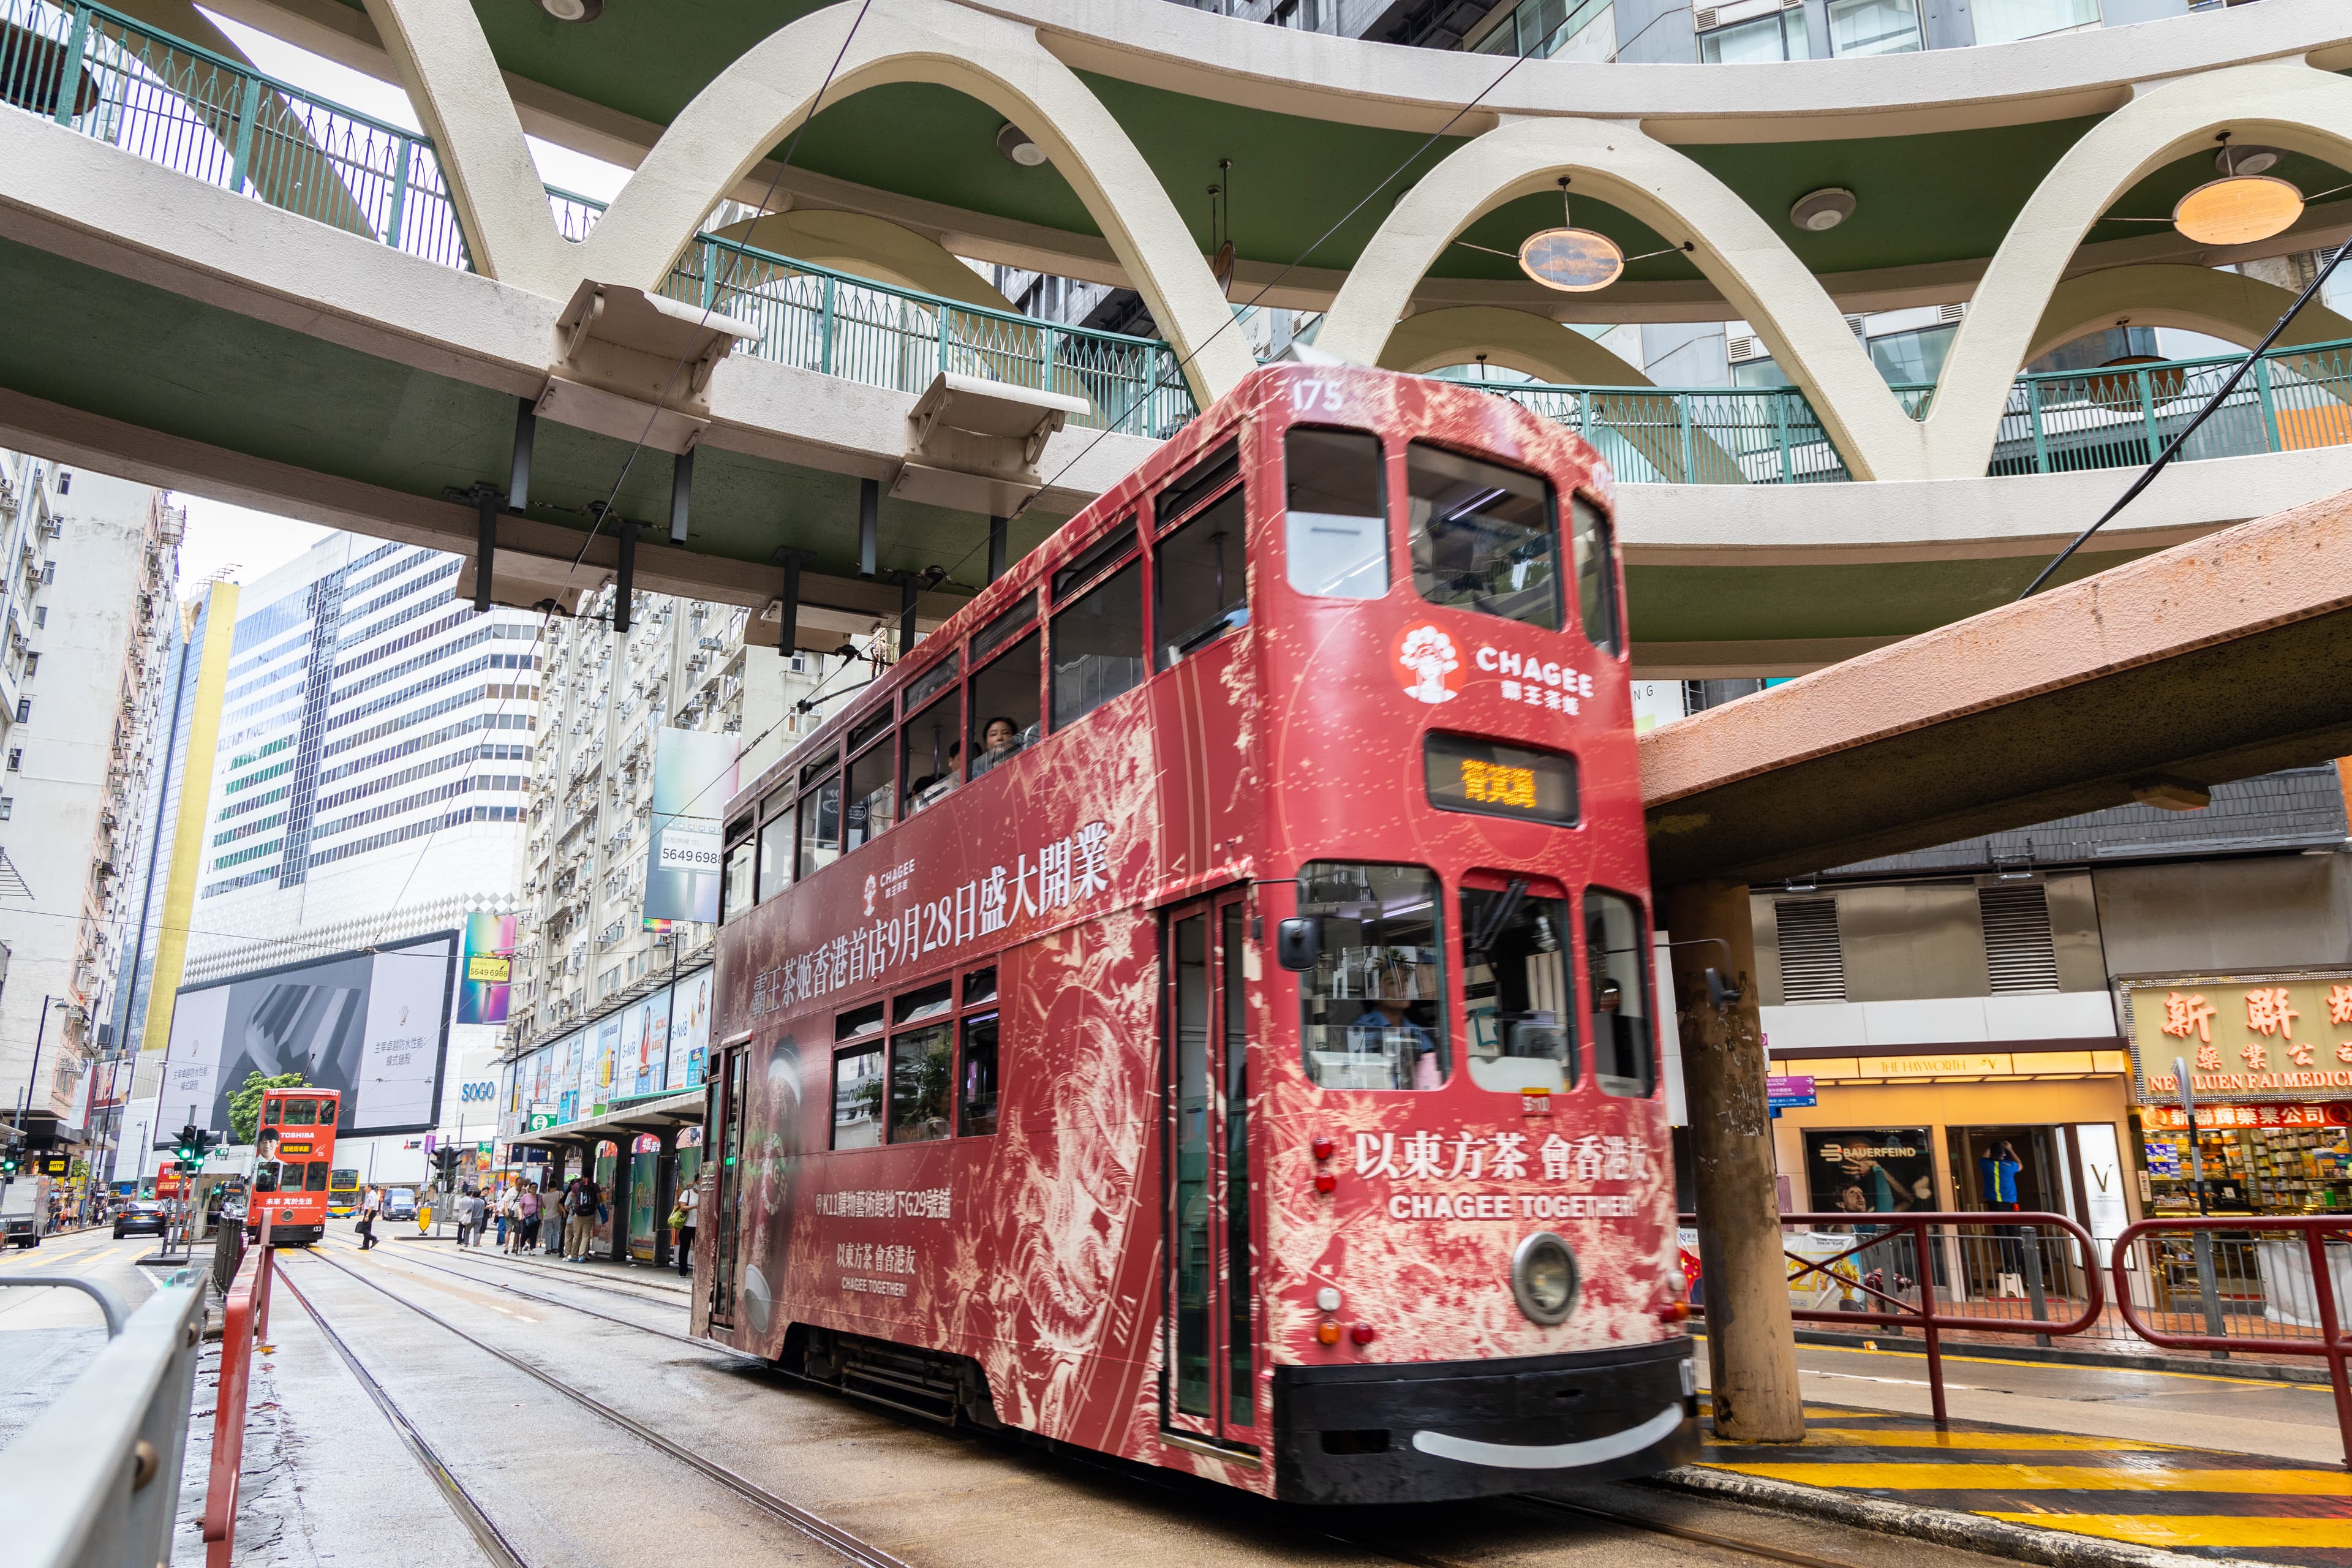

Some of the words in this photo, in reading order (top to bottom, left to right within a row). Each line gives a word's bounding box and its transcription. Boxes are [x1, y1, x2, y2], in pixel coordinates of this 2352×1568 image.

[1293, 378, 1343, 412] 175
[1476, 647, 1594, 698] CHAGEE
[663, 848, 693, 861] 5649
[880, 858, 915, 888] CHAGEE
[1881, 1062, 1898, 1072] THE
[1902, 1060, 1966, 1072] HAYWORTH
[461, 1080, 495, 1102] SOGO
[2148, 1074, 2180, 1091] NE
[2193, 1072, 2242, 1091] LUEN
[2244, 1072, 2280, 1090] FAI
[1355, 1131, 1529, 1180] 以東方茶
[1539, 1133, 1650, 1182] 會香港友
[1844, 1147, 1917, 1158] BAUERFEIND
[1389, 1195, 1513, 1219] CHAGEE
[836, 1242, 873, 1270] 以東方茶
[875, 1244, 916, 1275] 會香港友
[842, 1276, 867, 1292] CHAGEE
[869, 1279, 907, 1297] TOGETHER!
